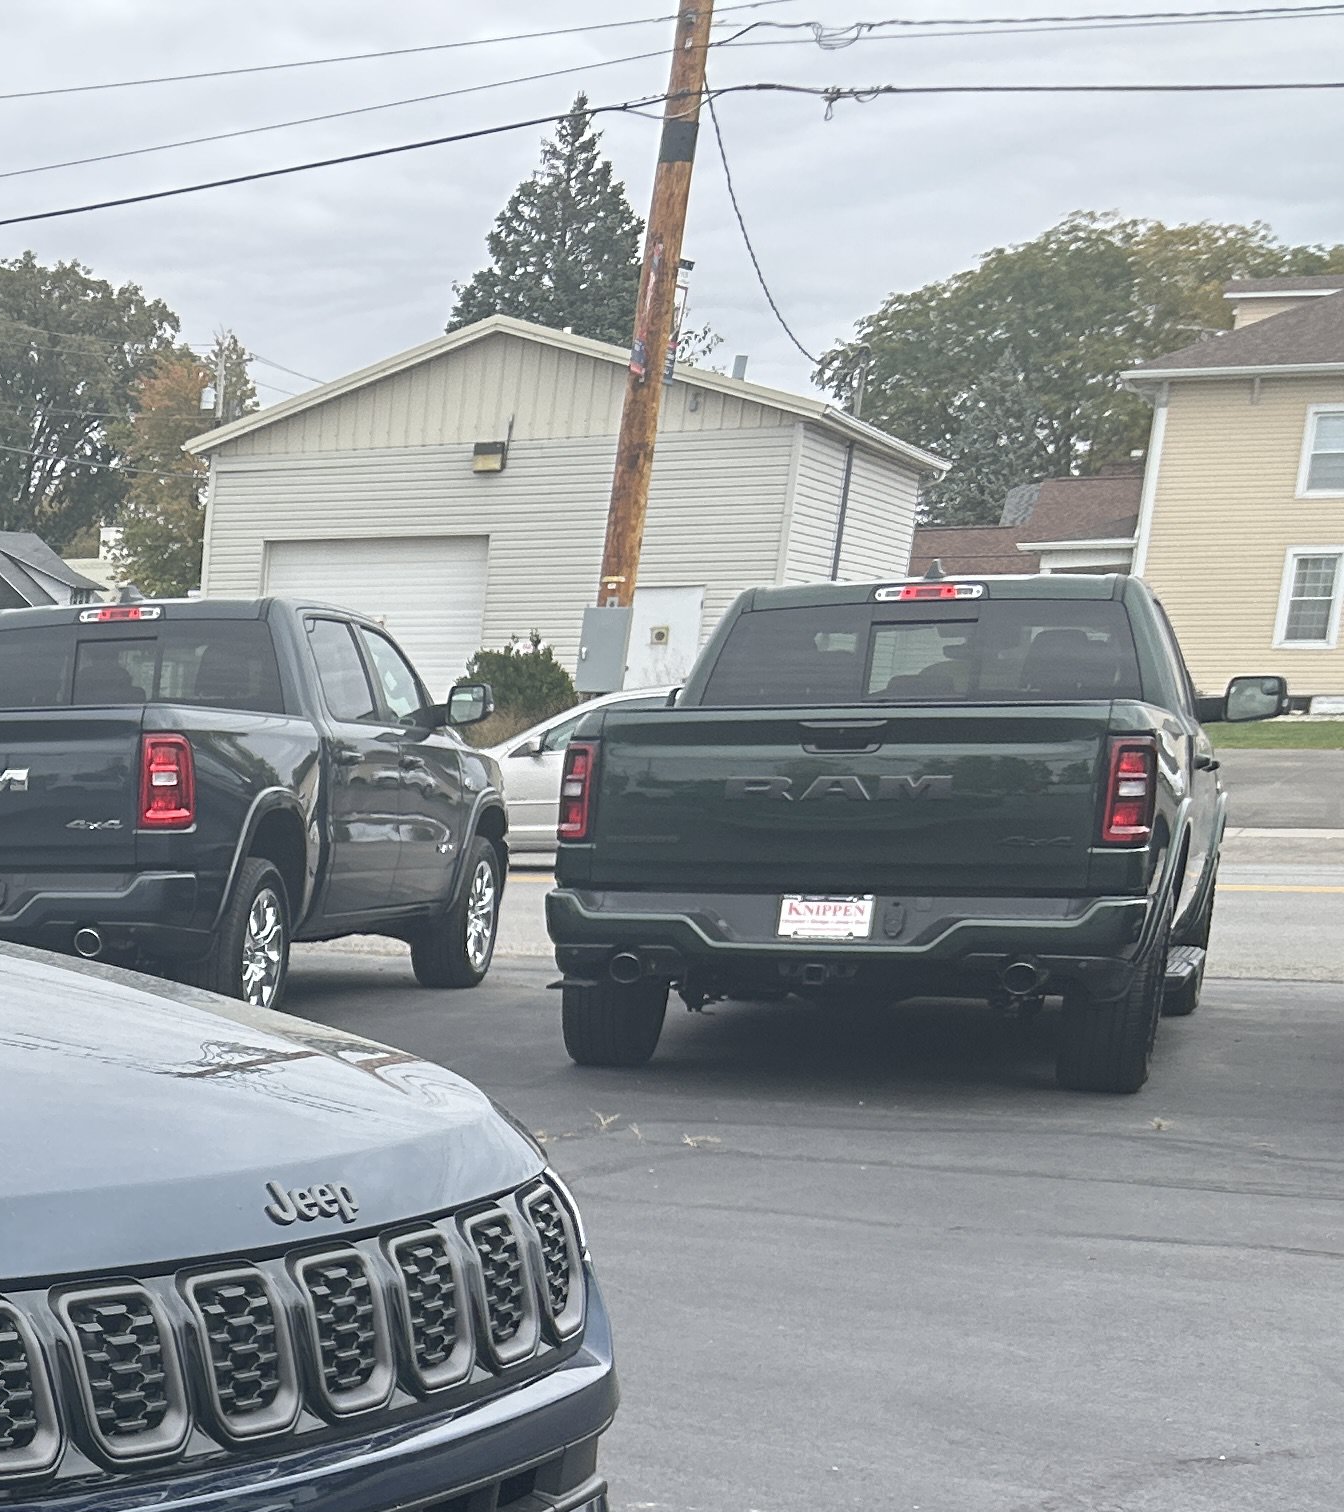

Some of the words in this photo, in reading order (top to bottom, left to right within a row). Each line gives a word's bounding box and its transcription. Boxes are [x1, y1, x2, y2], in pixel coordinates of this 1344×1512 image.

[724, 774, 954, 801] RAM
[787, 902, 866, 917] KNIPPEN
[264, 1180, 360, 1226] Jeep
